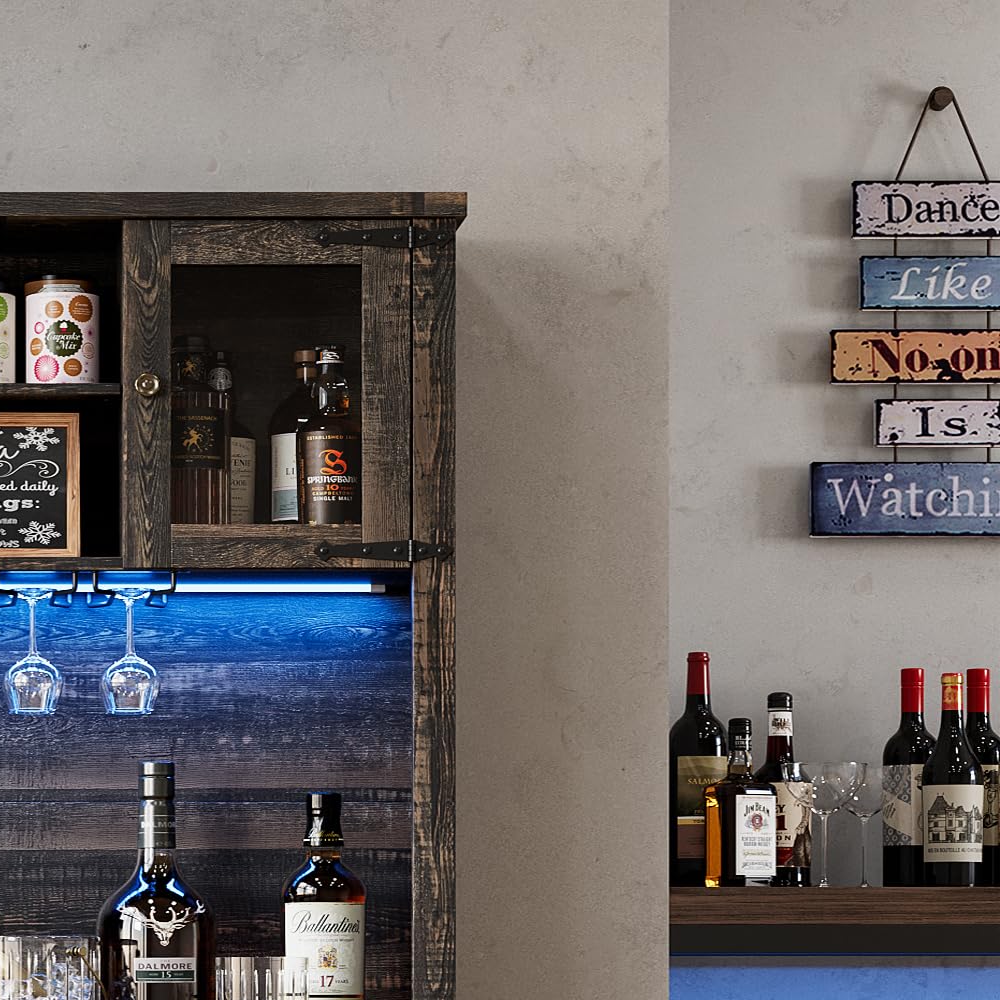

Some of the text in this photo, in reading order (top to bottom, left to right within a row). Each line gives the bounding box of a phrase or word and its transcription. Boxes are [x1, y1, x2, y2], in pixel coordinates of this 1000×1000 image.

[884, 192, 1000, 225] Dance
[890, 261, 993, 302] Like
[47, 332, 81, 342] Cupcake
[59, 341, 77, 350] Mix
[868, 338, 928, 375] No
[916, 406, 969, 438] Is
[20, 479, 59, 496] daily
[827, 472, 1000, 518] Watchi
[320, 975, 334, 987] 17
